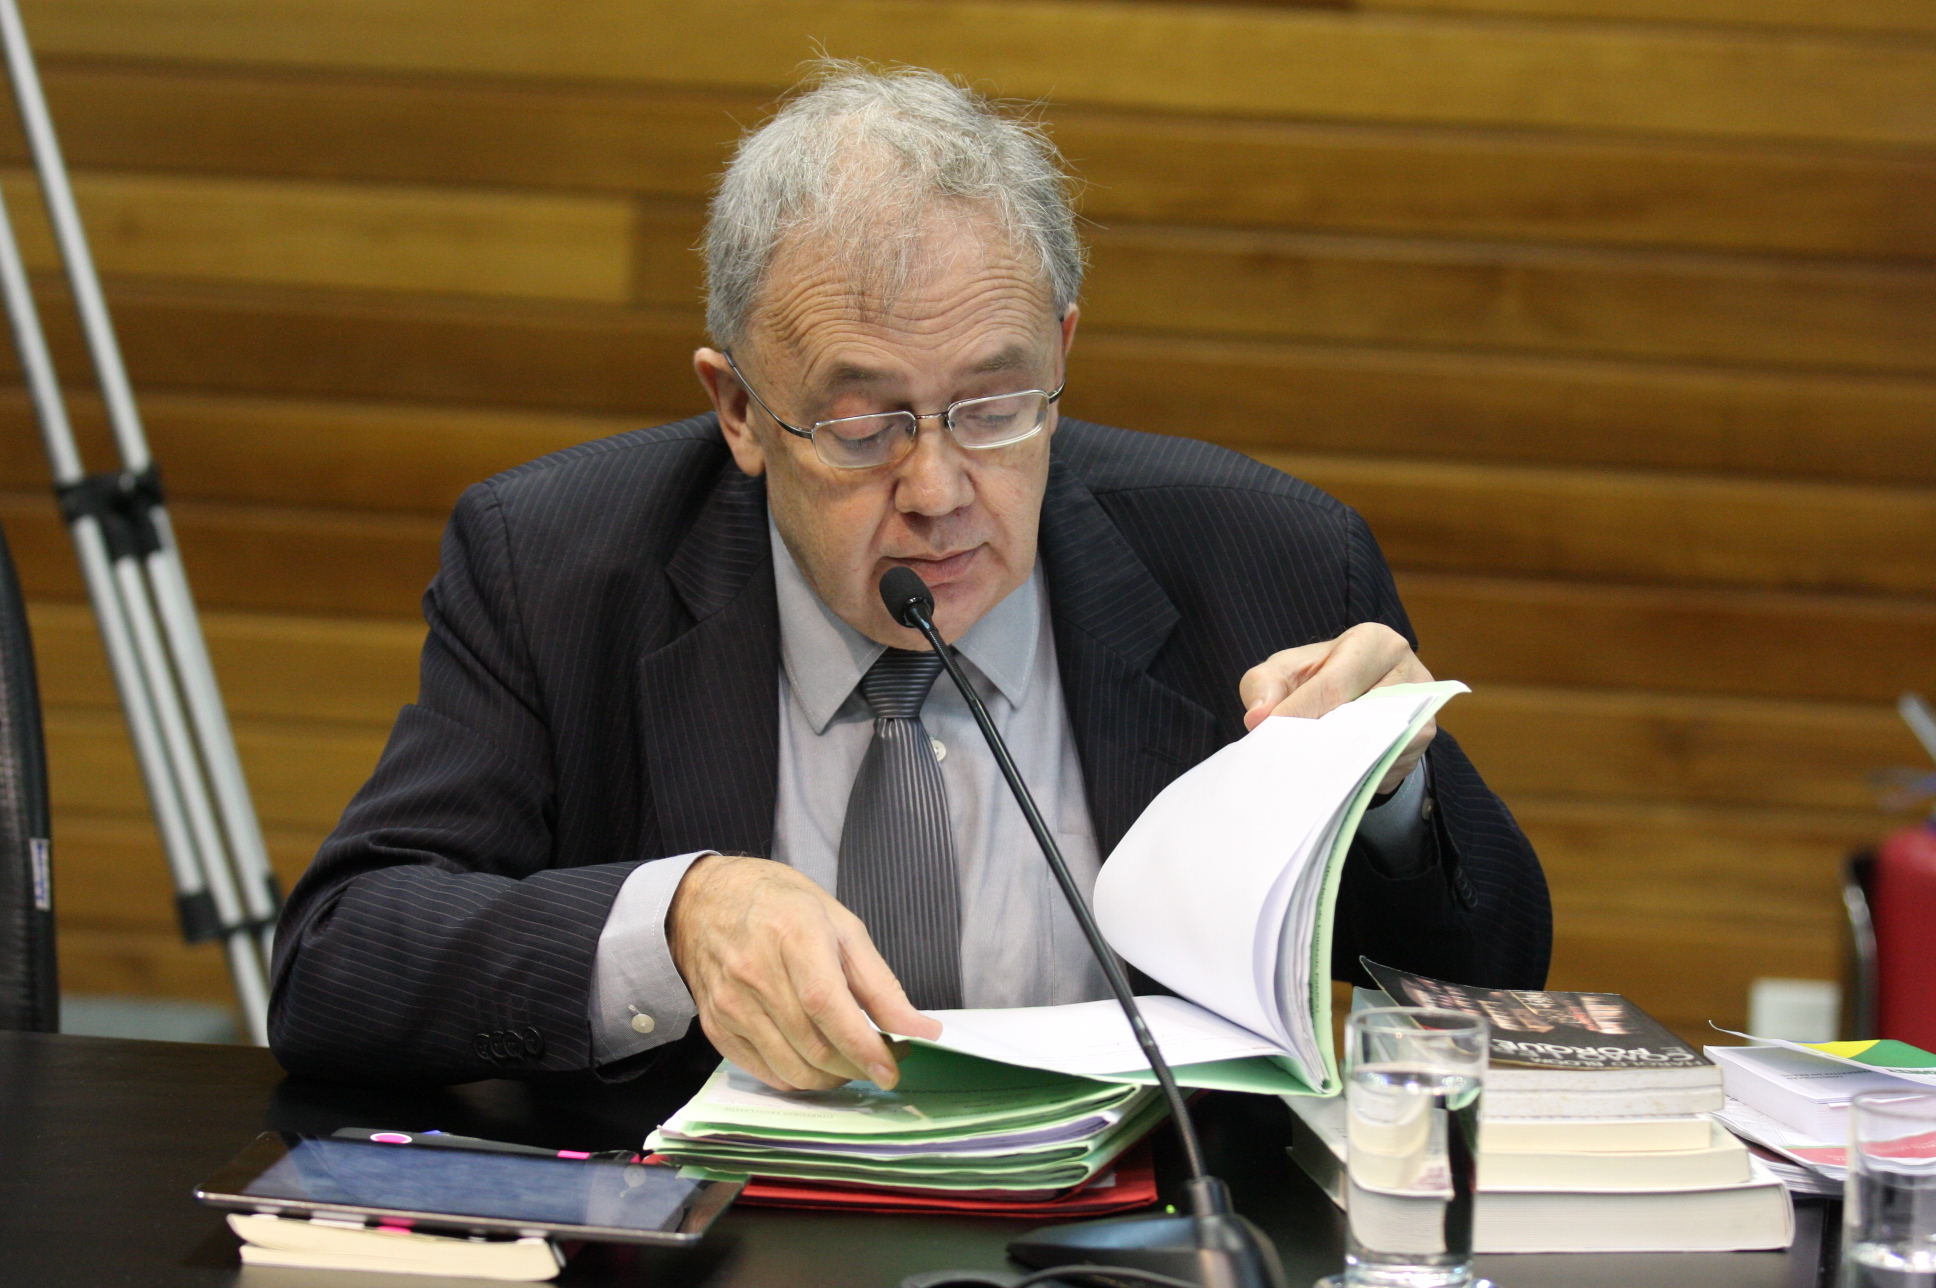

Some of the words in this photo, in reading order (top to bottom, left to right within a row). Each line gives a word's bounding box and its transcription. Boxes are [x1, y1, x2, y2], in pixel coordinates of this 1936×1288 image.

[1659, 1046, 1689, 1054] E
[1576, 1051, 1694, 1061] COMO
[1530, 1057, 1605, 1067] BLOOM
